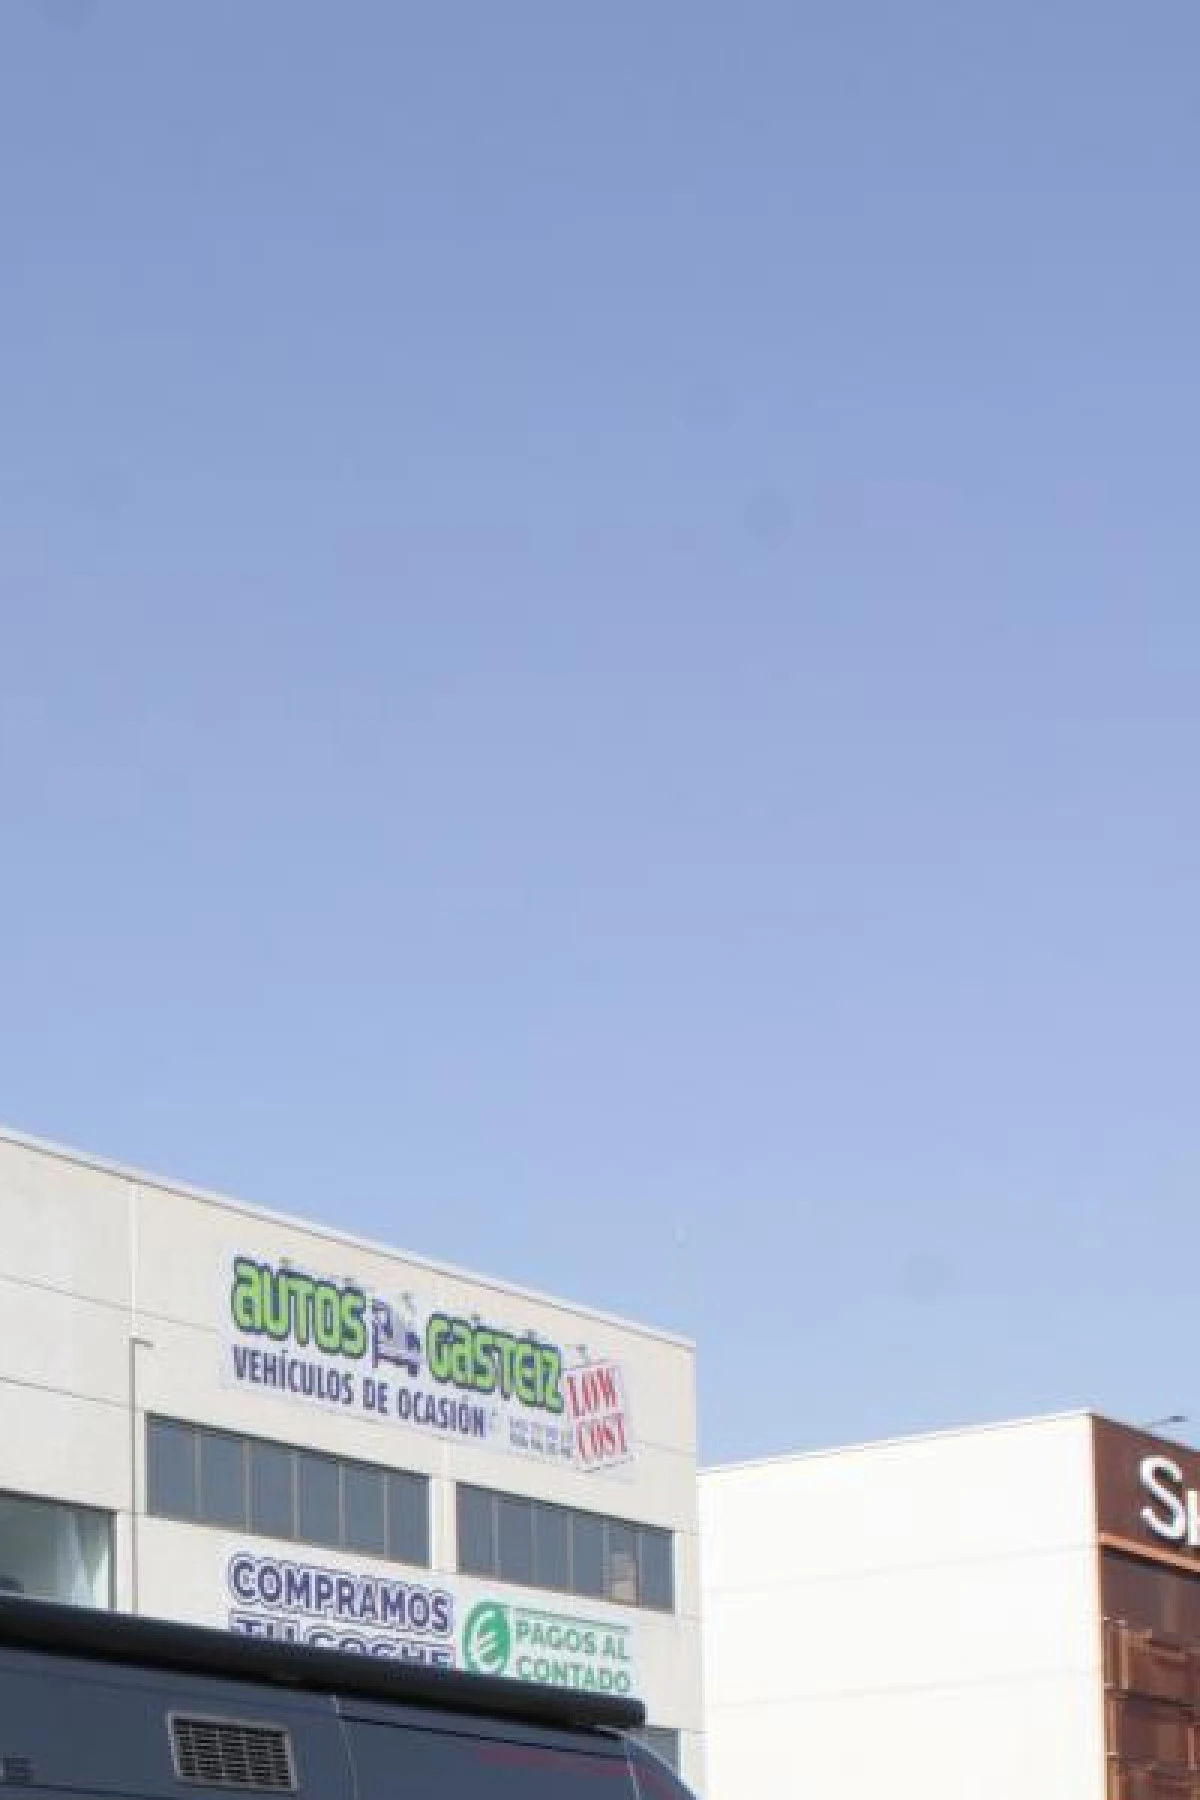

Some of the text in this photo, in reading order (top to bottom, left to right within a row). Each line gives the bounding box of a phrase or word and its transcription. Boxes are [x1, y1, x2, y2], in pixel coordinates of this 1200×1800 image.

[234, 1344, 354, 1404] VEHÍCULOS
[362, 1377, 388, 1413] DE
[398, 1388, 485, 1437] OCASIÓN
[567, 1367, 617, 1416] LOW
[576, 1413, 627, 1463] COST
[234, 1561, 451, 1632] COMPRAMOS
[516, 1620, 631, 1661] PAGOS AL
[517, 1656, 631, 1693] CONTADO
